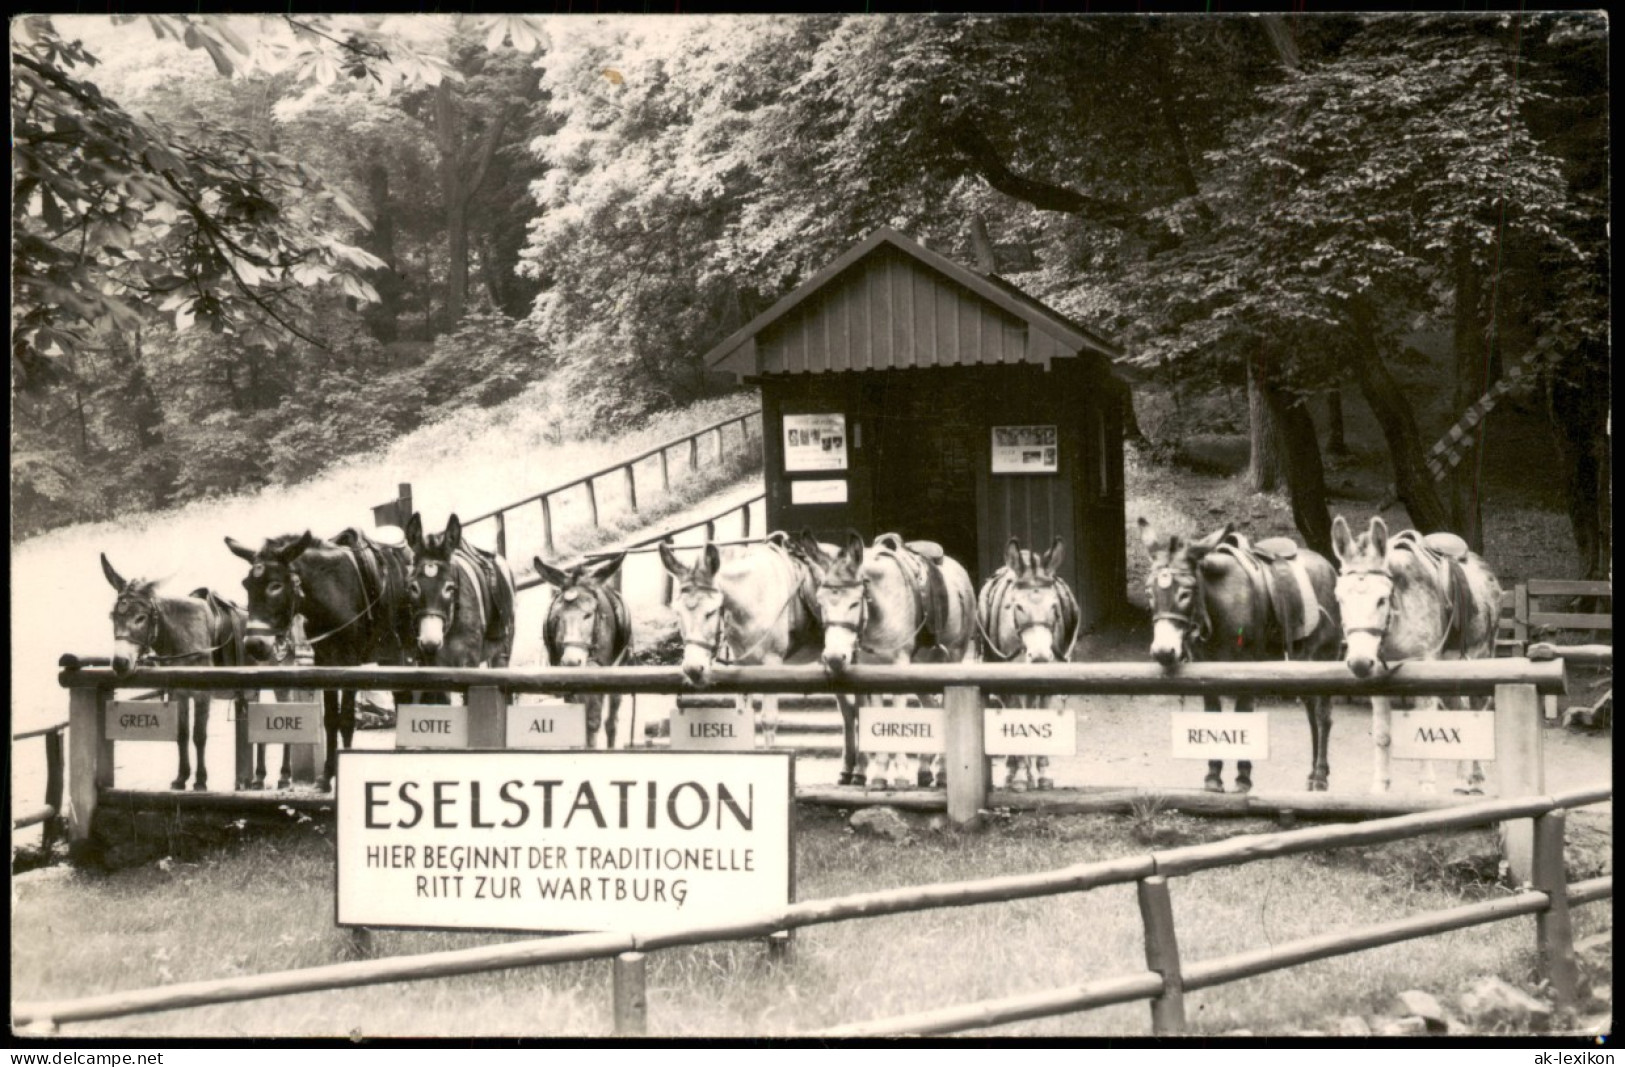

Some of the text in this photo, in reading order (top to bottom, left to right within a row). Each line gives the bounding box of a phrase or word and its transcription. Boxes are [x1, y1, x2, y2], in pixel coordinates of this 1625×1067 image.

[120, 714, 160, 728] GRETA
[266, 716, 303, 730] LORE
[411, 719, 452, 733] LOTTE
[528, 718, 554, 733] ALI
[690, 722, 737, 738] LIESEL
[871, 722, 934, 738] CHRISTEL
[1000, 723, 1053, 739] HANS
[1188, 728, 1249, 745] RENATE
[1414, 727, 1461, 743] MAX
[363, 779, 754, 831] ESELSTATION
[366, 845, 755, 872] HIER BEGINNT DER TRADITIONELLE
[416, 876, 688, 905] RITT ZUR WARTBURG
